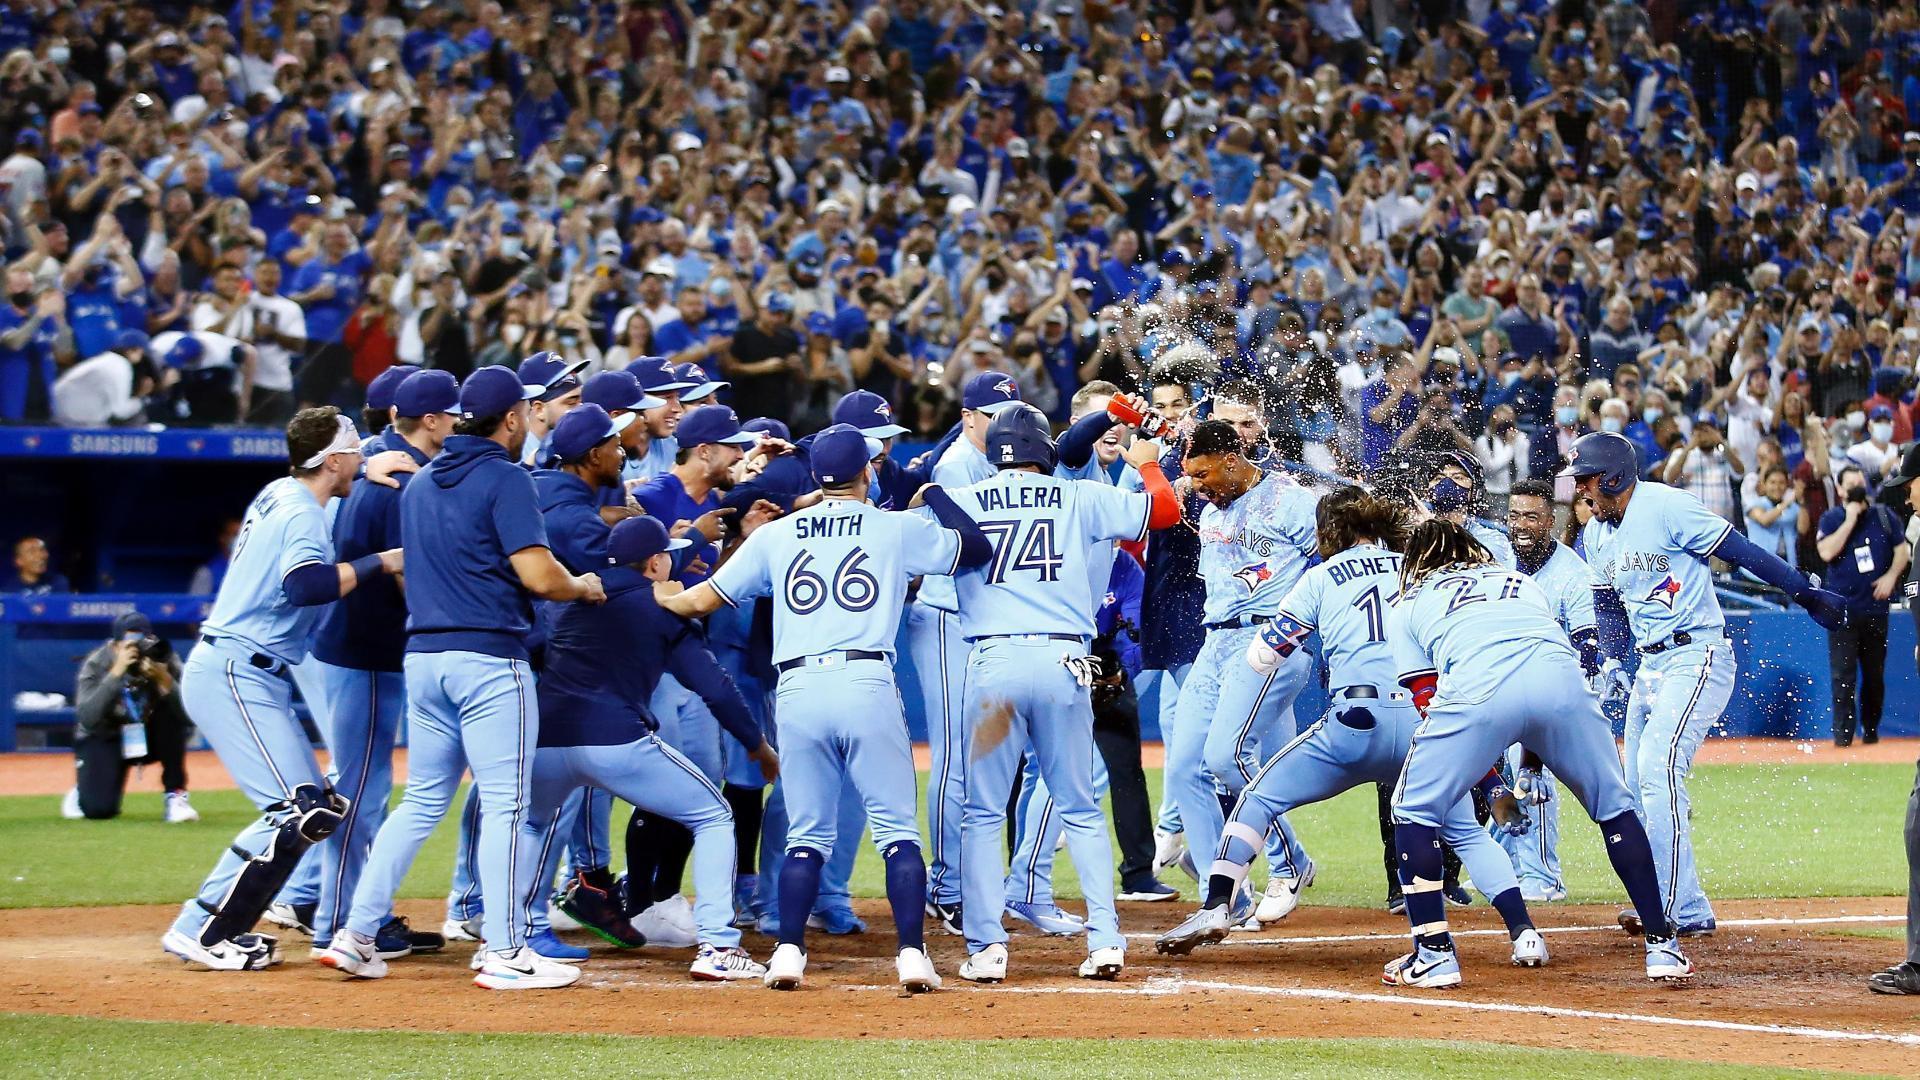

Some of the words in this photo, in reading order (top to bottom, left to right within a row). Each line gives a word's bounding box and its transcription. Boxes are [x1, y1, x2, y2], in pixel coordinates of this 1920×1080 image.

[70, 434, 158, 454] SAMSUNG
[1001, 444, 1013, 454] 74
[976, 486, 1062, 512] VALERA
[796, 514, 863, 539] SMITH
[976, 518, 1063, 585] 74
[1227, 525, 1274, 557] JAYS
[1327, 556, 1400, 587] BICHET
[1621, 551, 1670, 572] JAYS
[784, 545, 880, 615] 66
